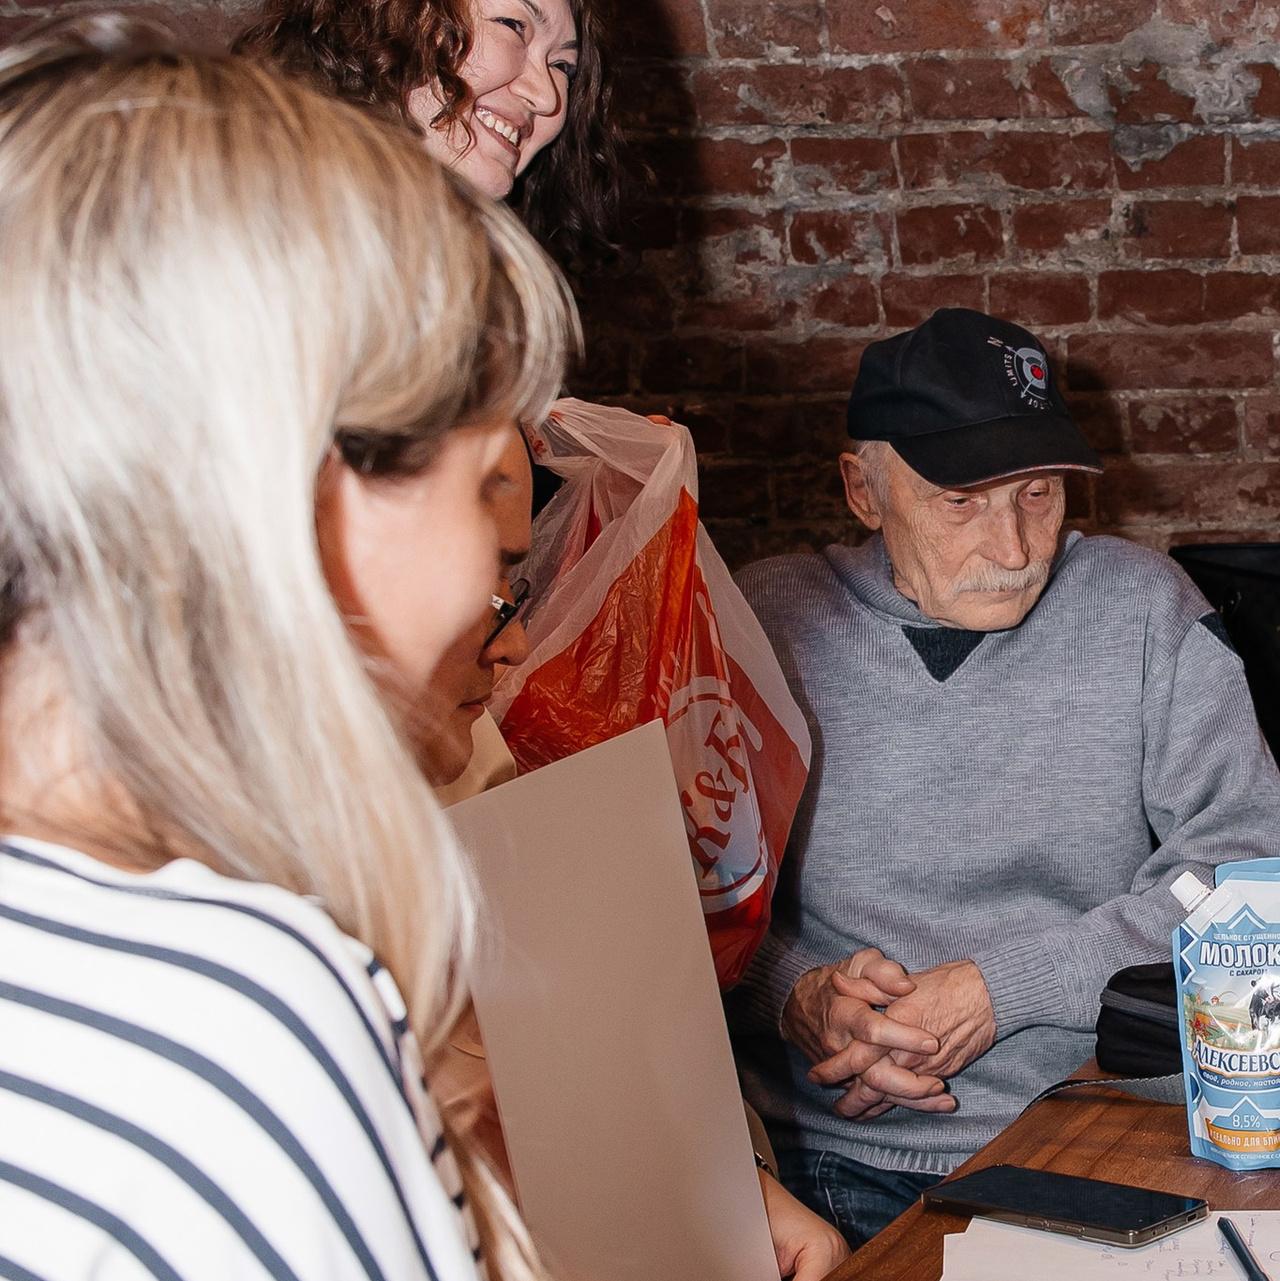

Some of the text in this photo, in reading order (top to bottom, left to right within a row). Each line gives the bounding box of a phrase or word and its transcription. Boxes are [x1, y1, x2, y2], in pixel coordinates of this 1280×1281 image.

[1003, 353, 1019, 387] LIMITS
[1232, 1114, 1261, 1128] 8,5%
[1244, 1137, 1260, 1147] ДЛЯ
